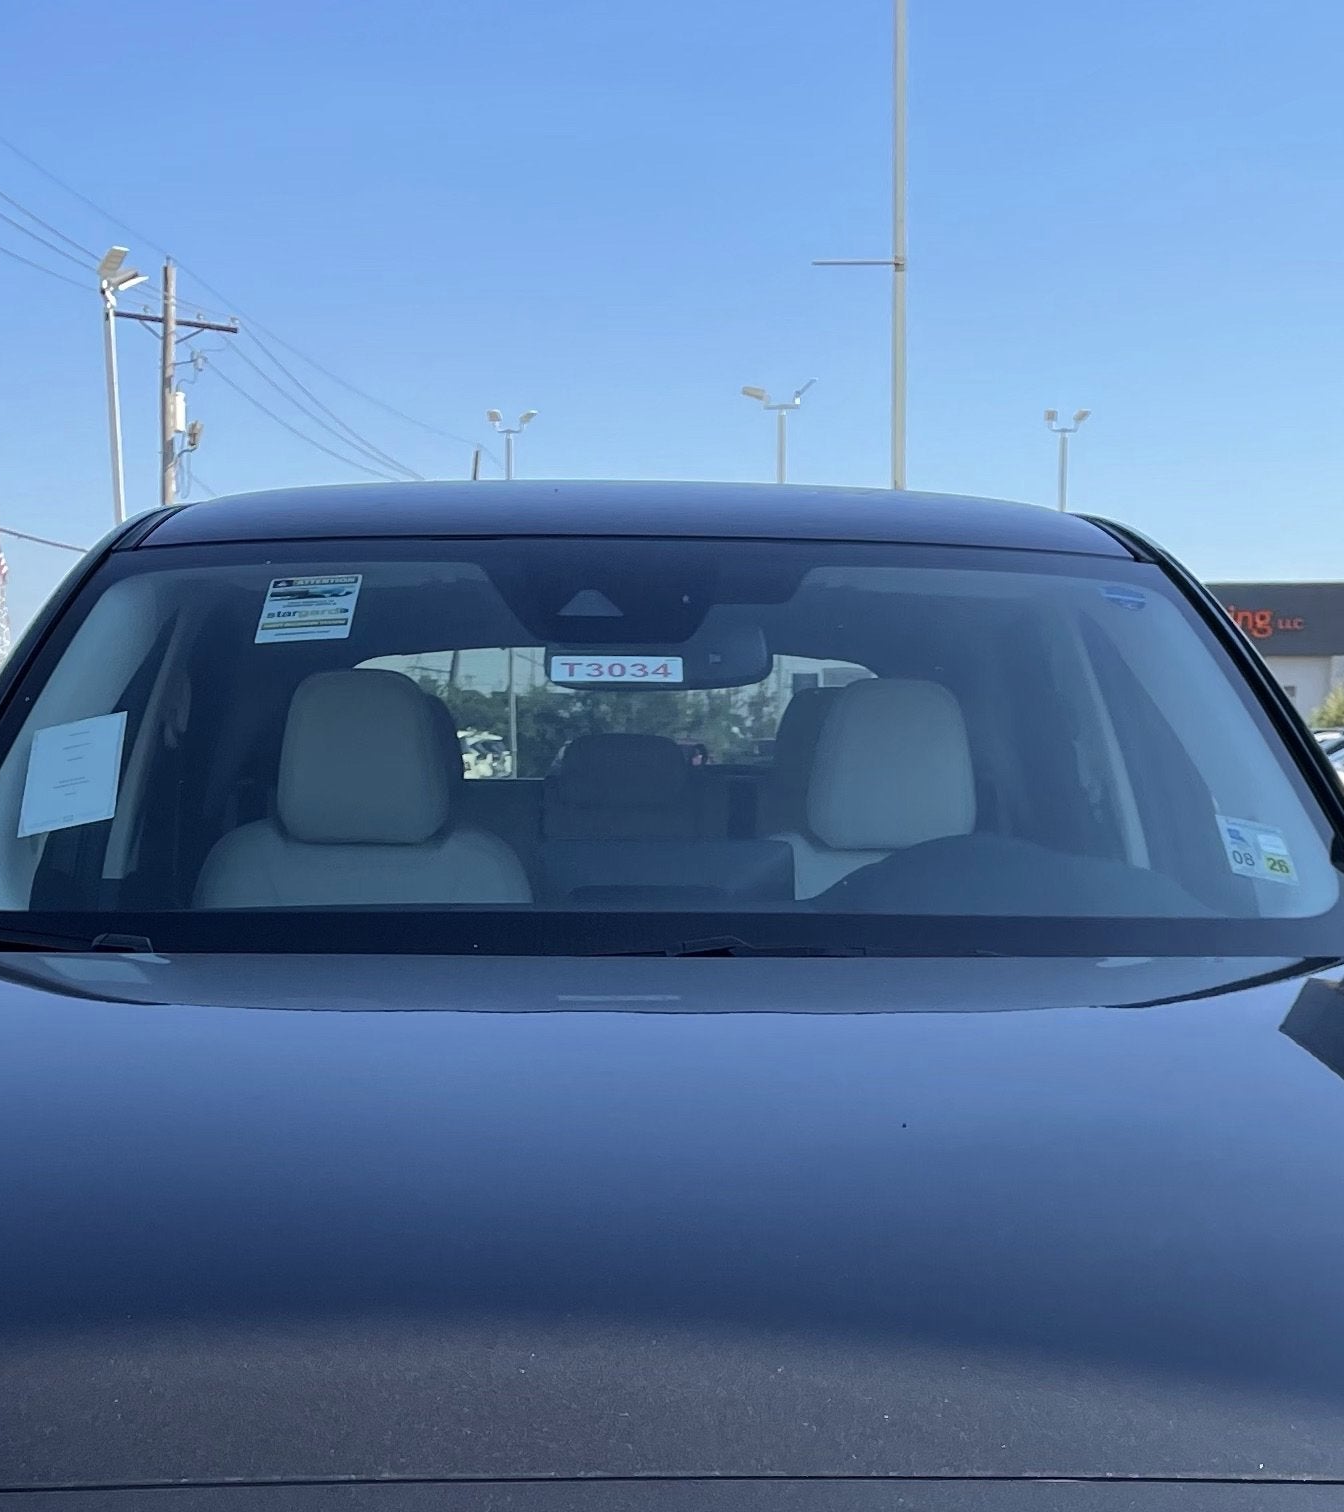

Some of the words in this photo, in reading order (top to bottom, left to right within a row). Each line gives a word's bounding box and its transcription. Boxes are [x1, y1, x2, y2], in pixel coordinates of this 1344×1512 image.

[1277, 617, 1304, 629] LLC
[560, 662, 672, 678] T3034
[1232, 850, 1255, 867] 08
[1266, 857, 1290, 874] 26
